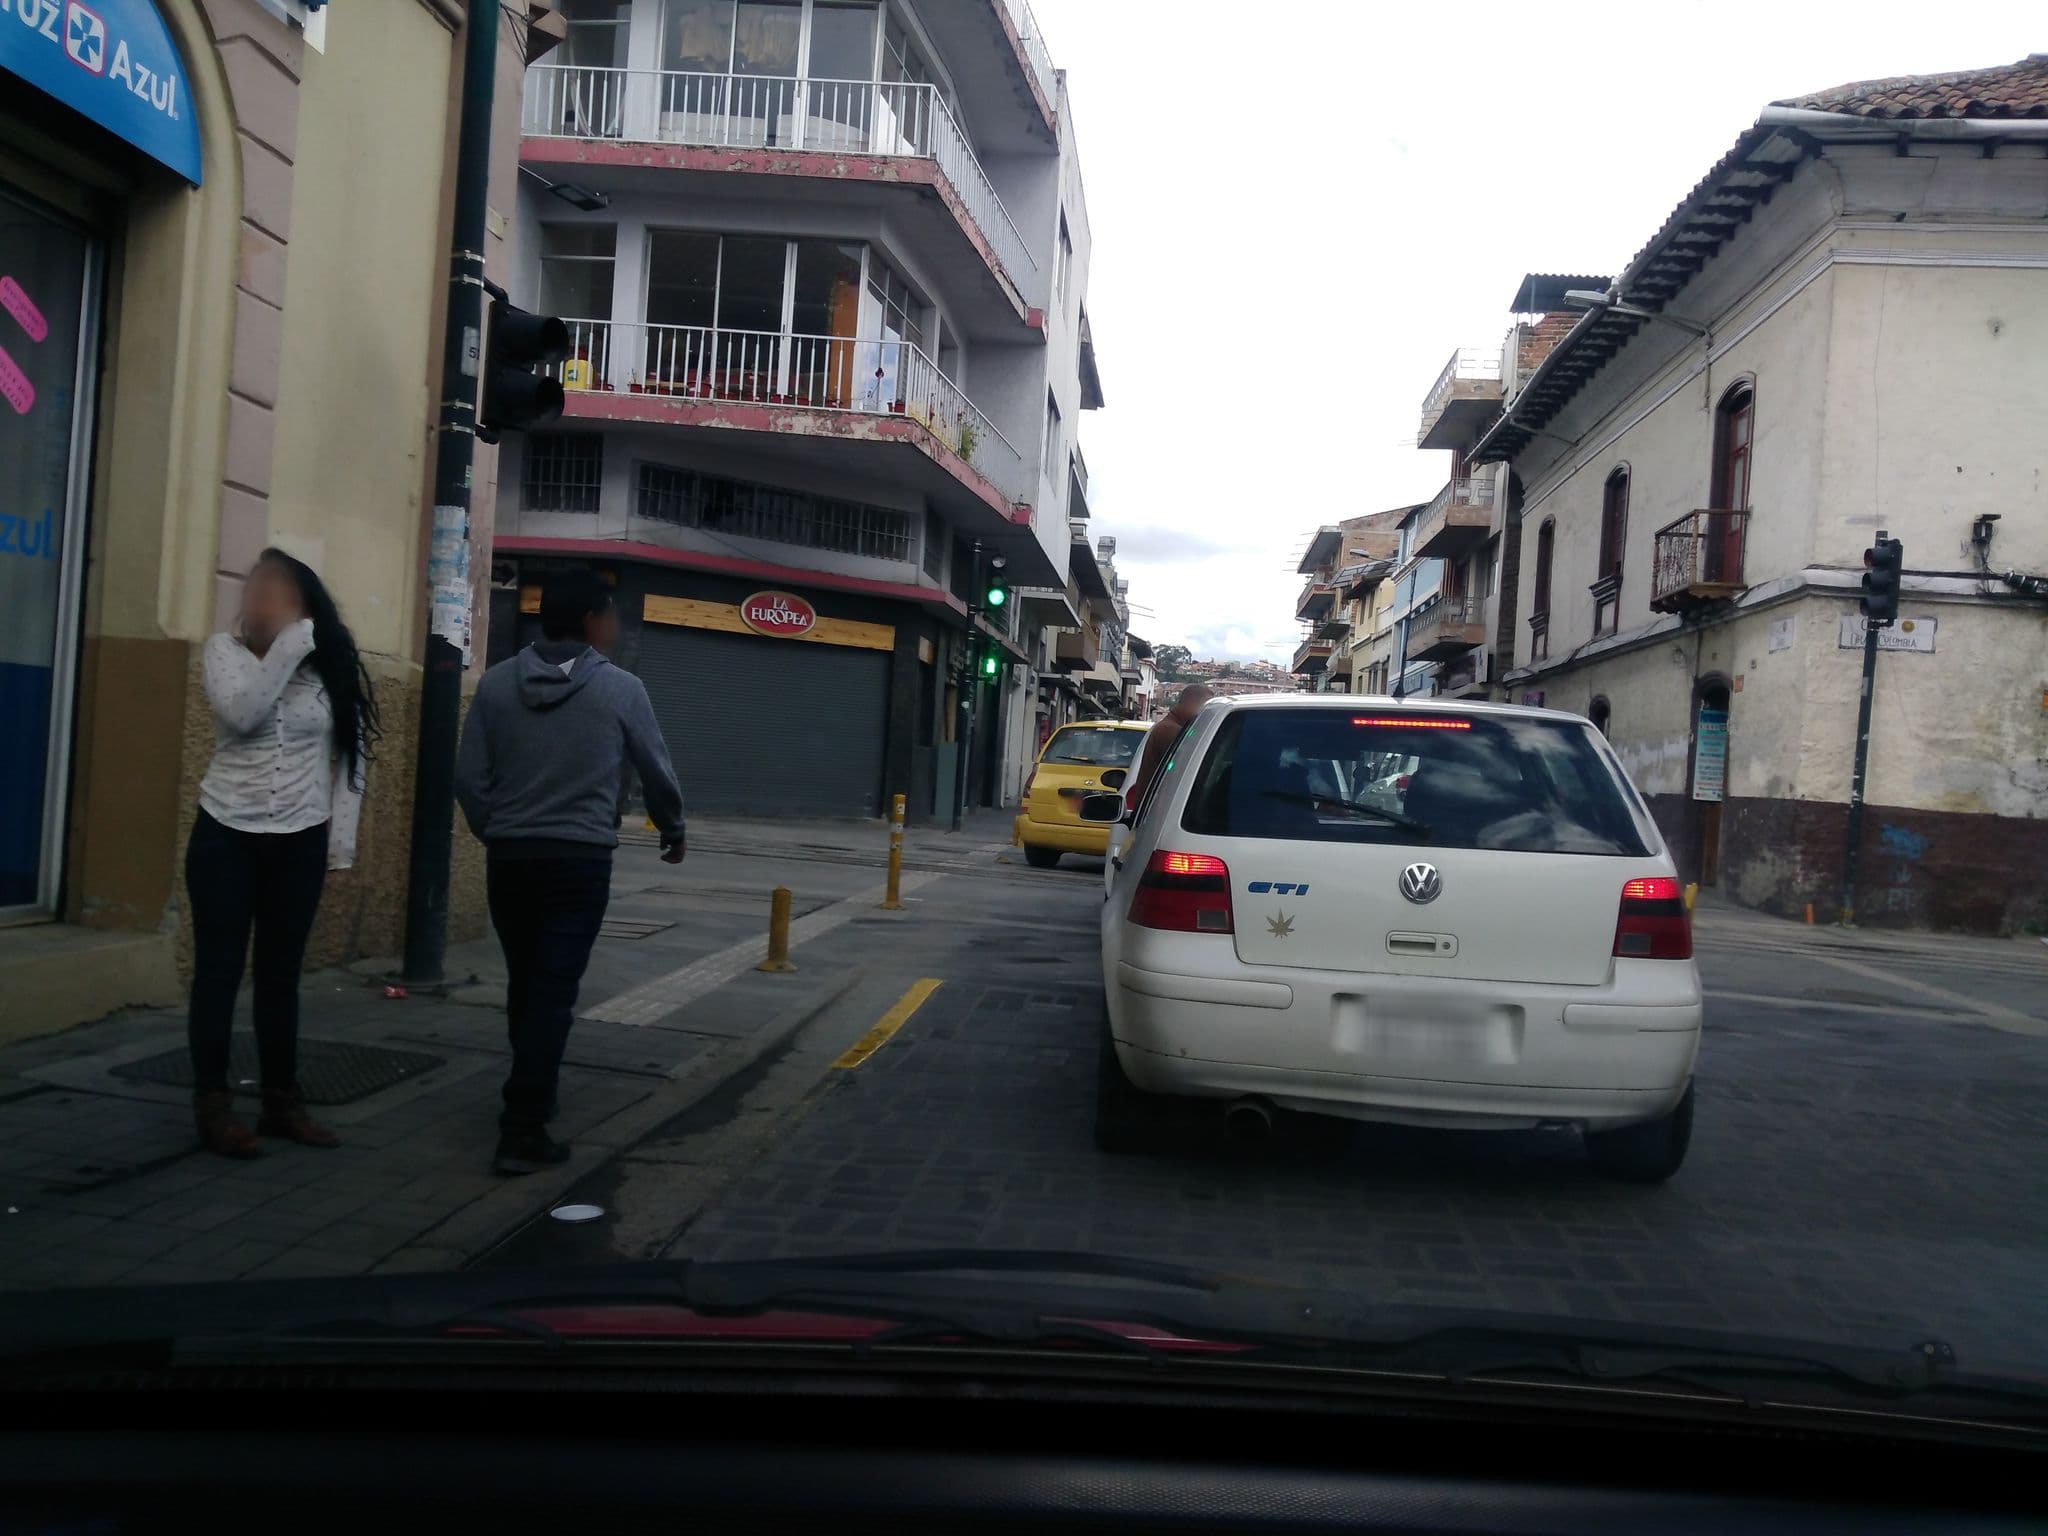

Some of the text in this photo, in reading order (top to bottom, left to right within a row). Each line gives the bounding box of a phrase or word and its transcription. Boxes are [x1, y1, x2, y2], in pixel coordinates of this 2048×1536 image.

[109, 40, 176, 118] Azul
[773, 597, 789, 610] LA
[751, 607, 808, 625] EUROPEA
[1248, 881, 1310, 896] GTI
